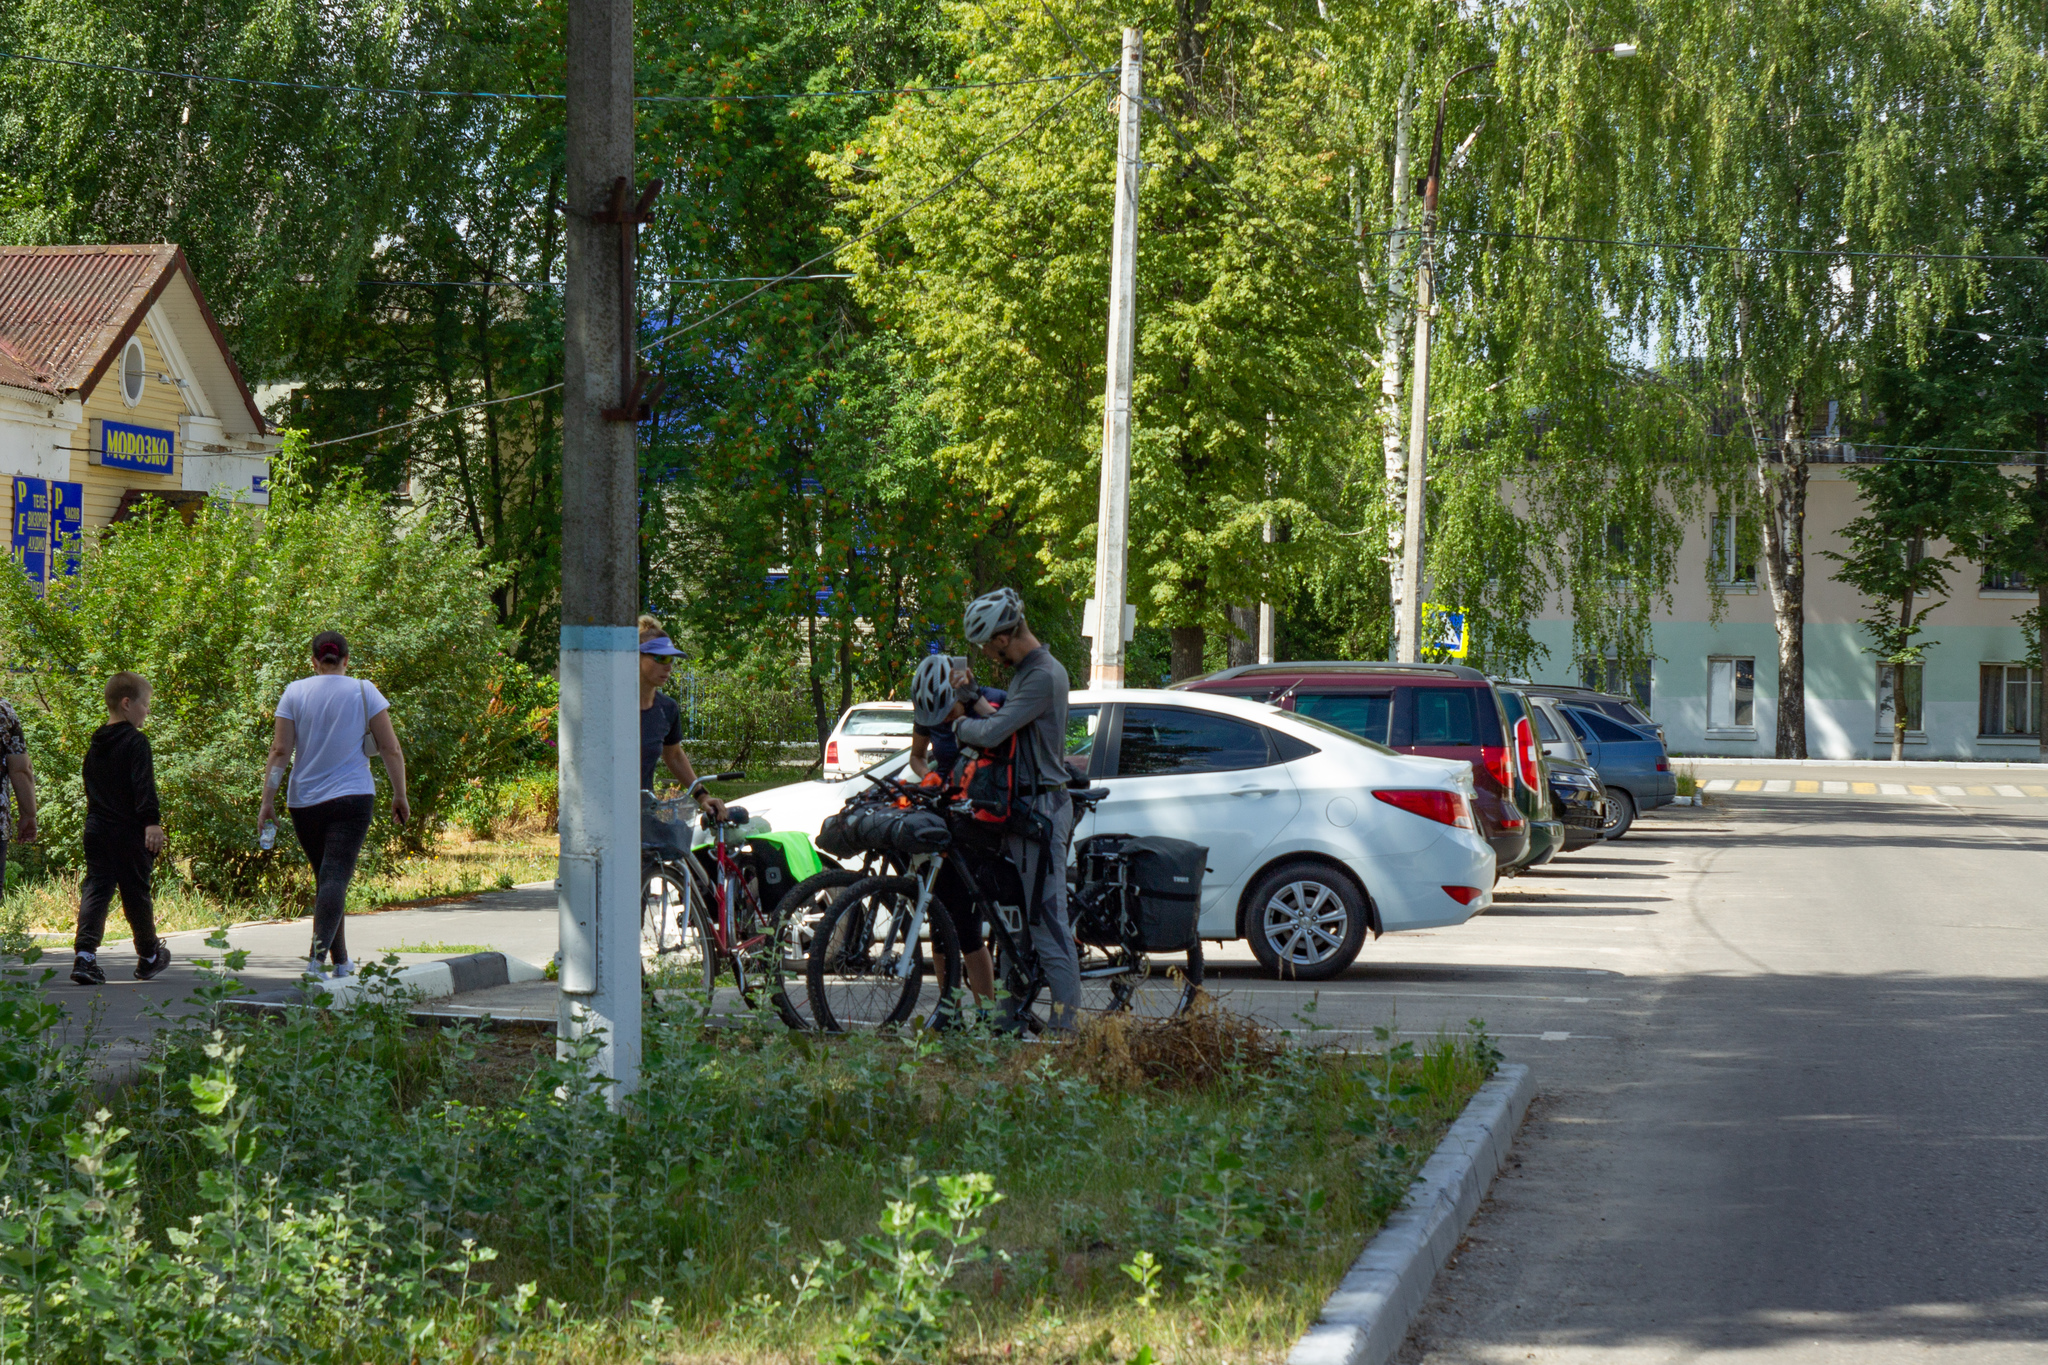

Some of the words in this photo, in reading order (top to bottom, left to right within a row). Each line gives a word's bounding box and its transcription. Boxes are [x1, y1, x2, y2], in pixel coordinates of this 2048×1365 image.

[107, 429, 169, 467] МОРОЗКО
[27, 511, 48, 529] ВИЗОРОВ
[64, 506, 80, 520] ЧАСОВ
[28, 536, 46, 552] АУДИО
